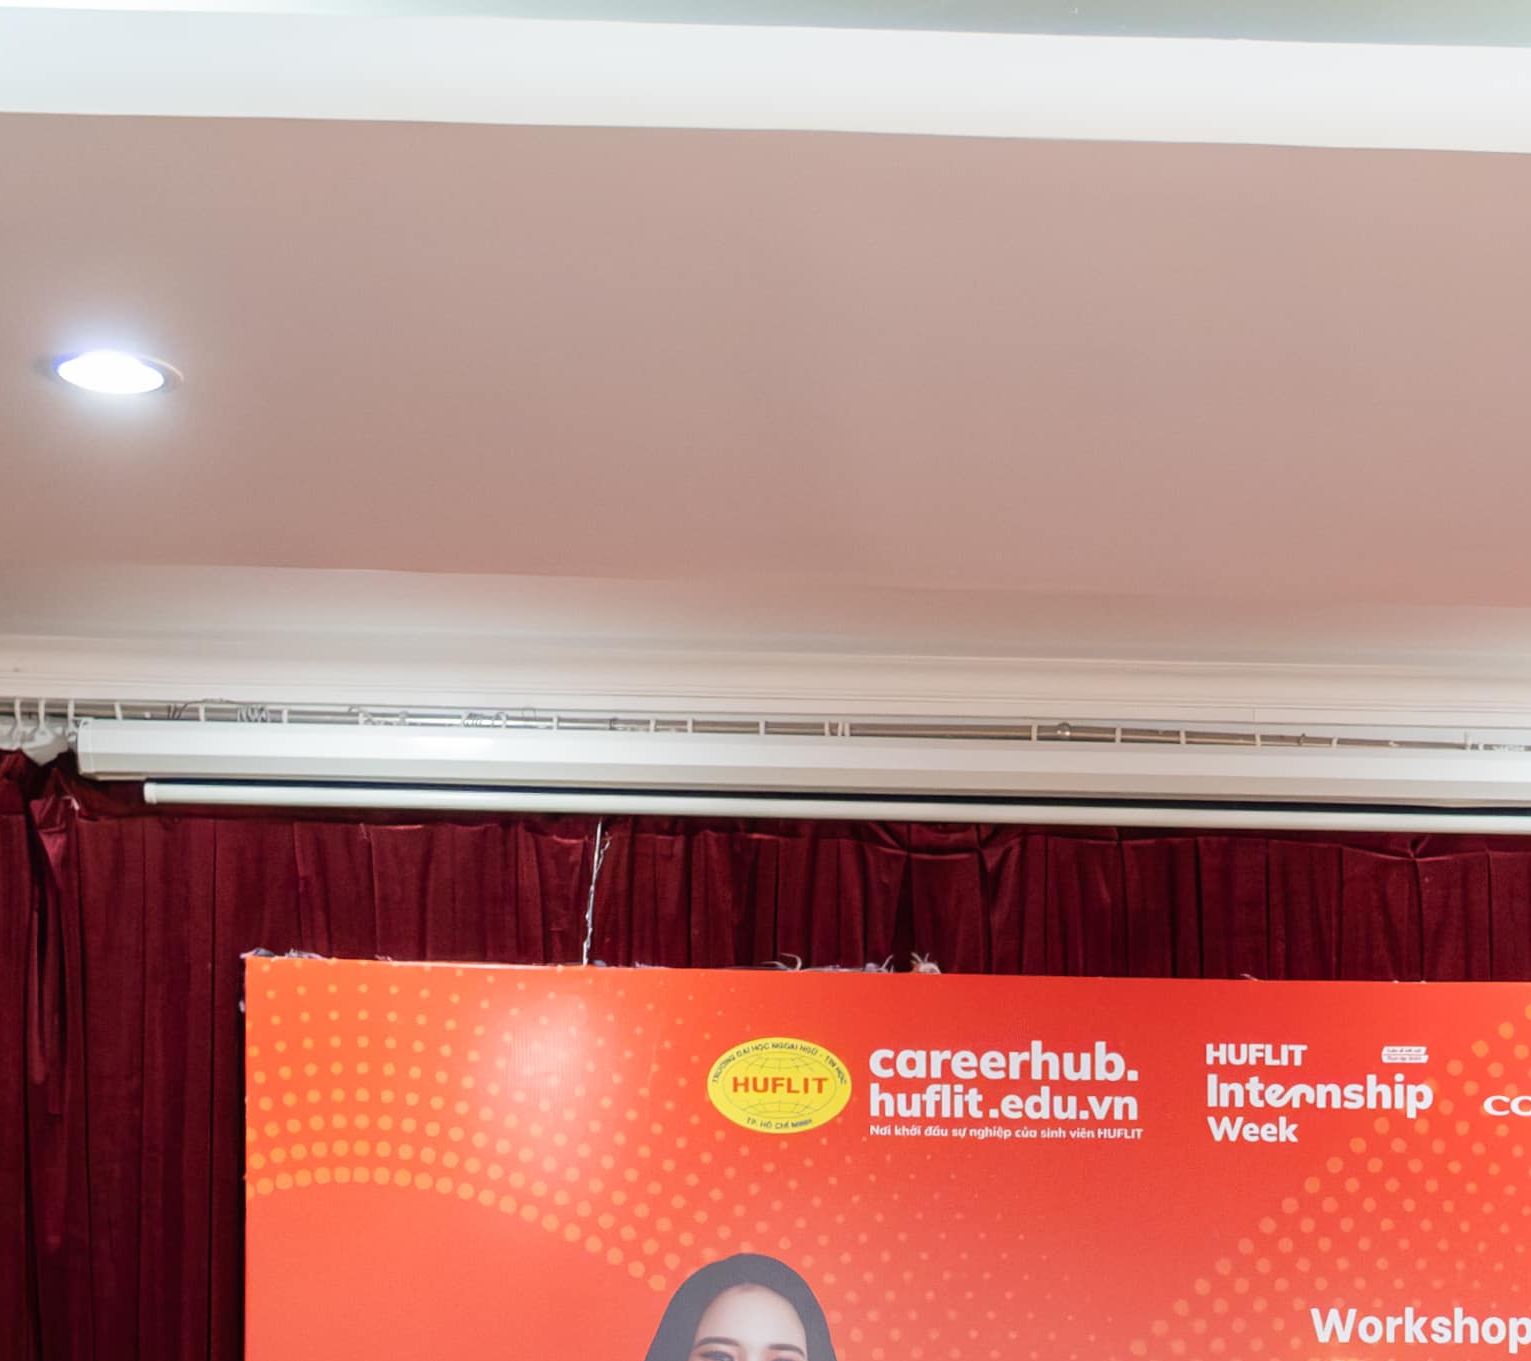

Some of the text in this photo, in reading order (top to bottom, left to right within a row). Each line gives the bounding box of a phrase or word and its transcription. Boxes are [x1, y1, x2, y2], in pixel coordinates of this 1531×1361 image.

[868, 1040, 1139, 1081] careerhub.
[1206, 1043, 1308, 1066] HUFLIT
[732, 1076, 829, 1094] HUFLIT
[1207, 1073, 1434, 1119] Internship
[1041, 1127, 1066, 1138] sinh
[1069, 1127, 1095, 1138] viên
[1097, 1128, 1143, 1139] HUFLIT
[1207, 1115, 1299, 1143] Week
